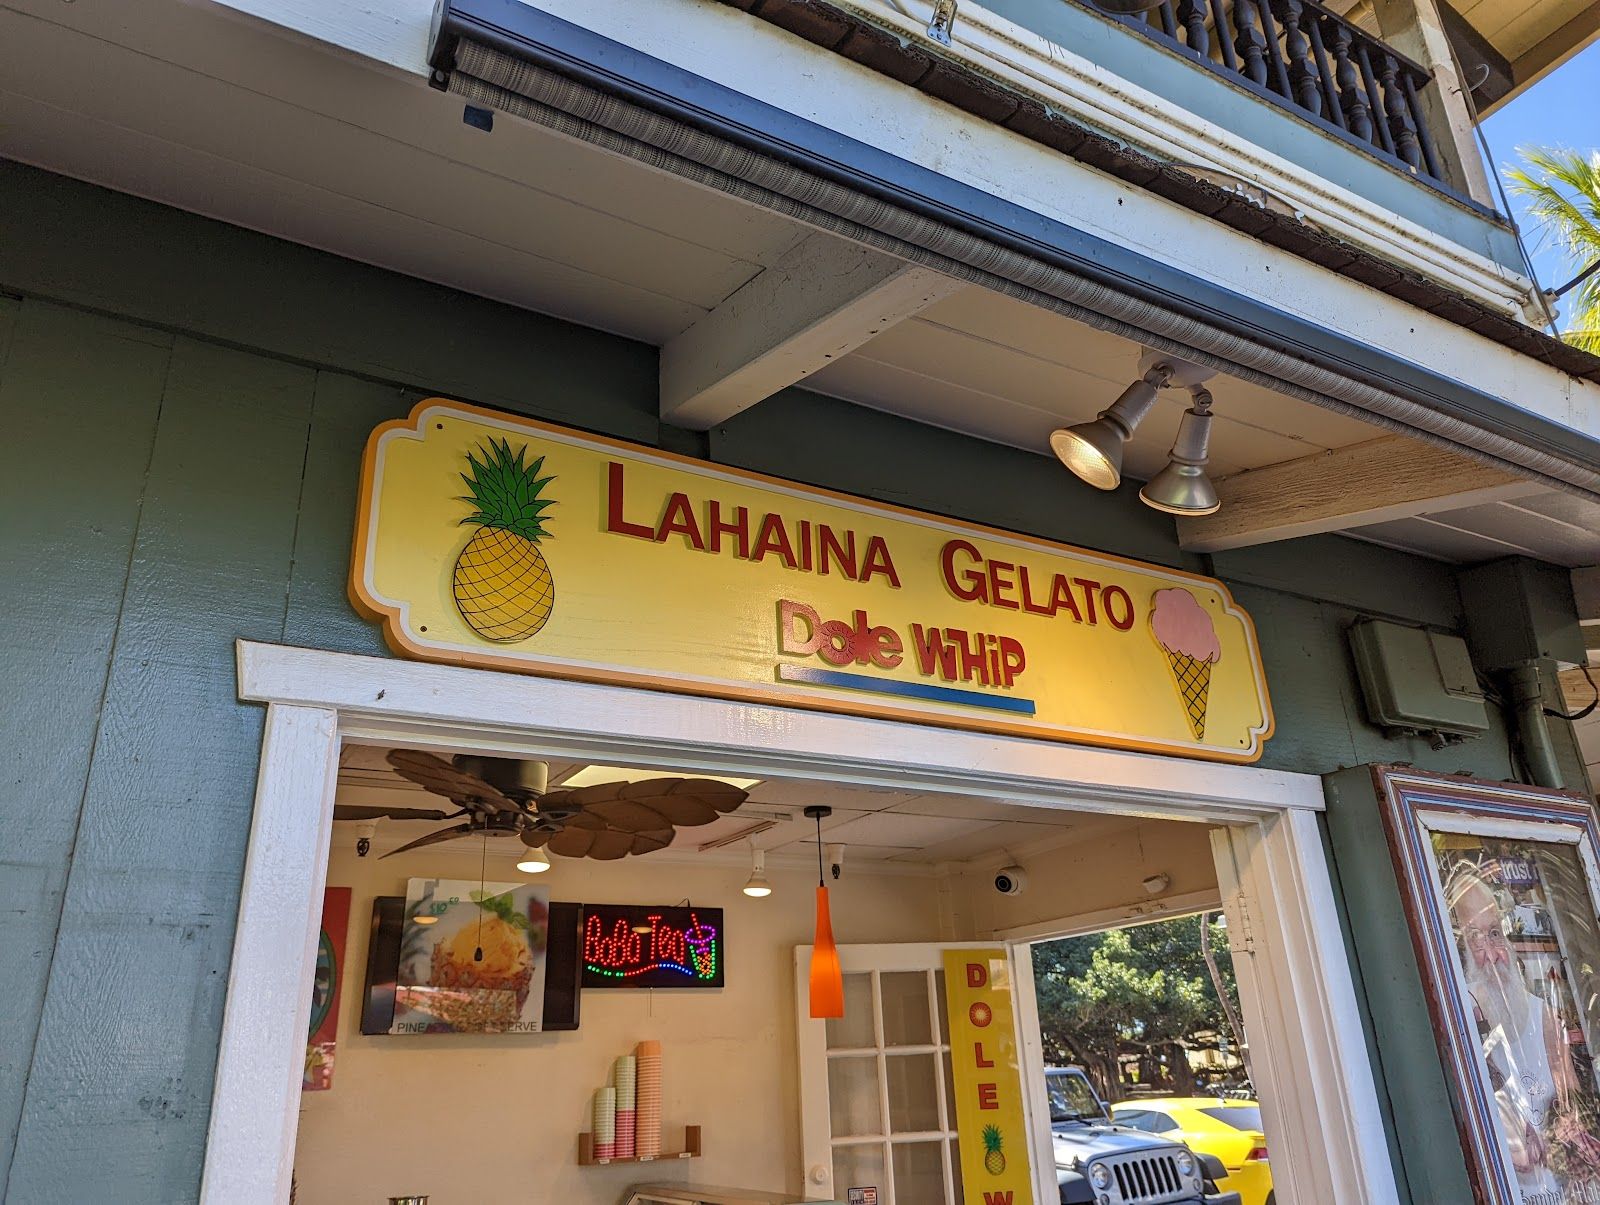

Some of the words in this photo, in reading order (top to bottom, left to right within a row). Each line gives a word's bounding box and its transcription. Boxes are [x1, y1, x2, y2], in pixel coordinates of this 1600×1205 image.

[607, 461, 901, 588] LAHAINA
[941, 539, 1135, 631] GELATO
[777, 599, 904, 668] Dole
[1500, 860, 1533, 880] trust
[647, 915, 685, 965] Tea
[966, 963, 1000, 1110] DOLE
